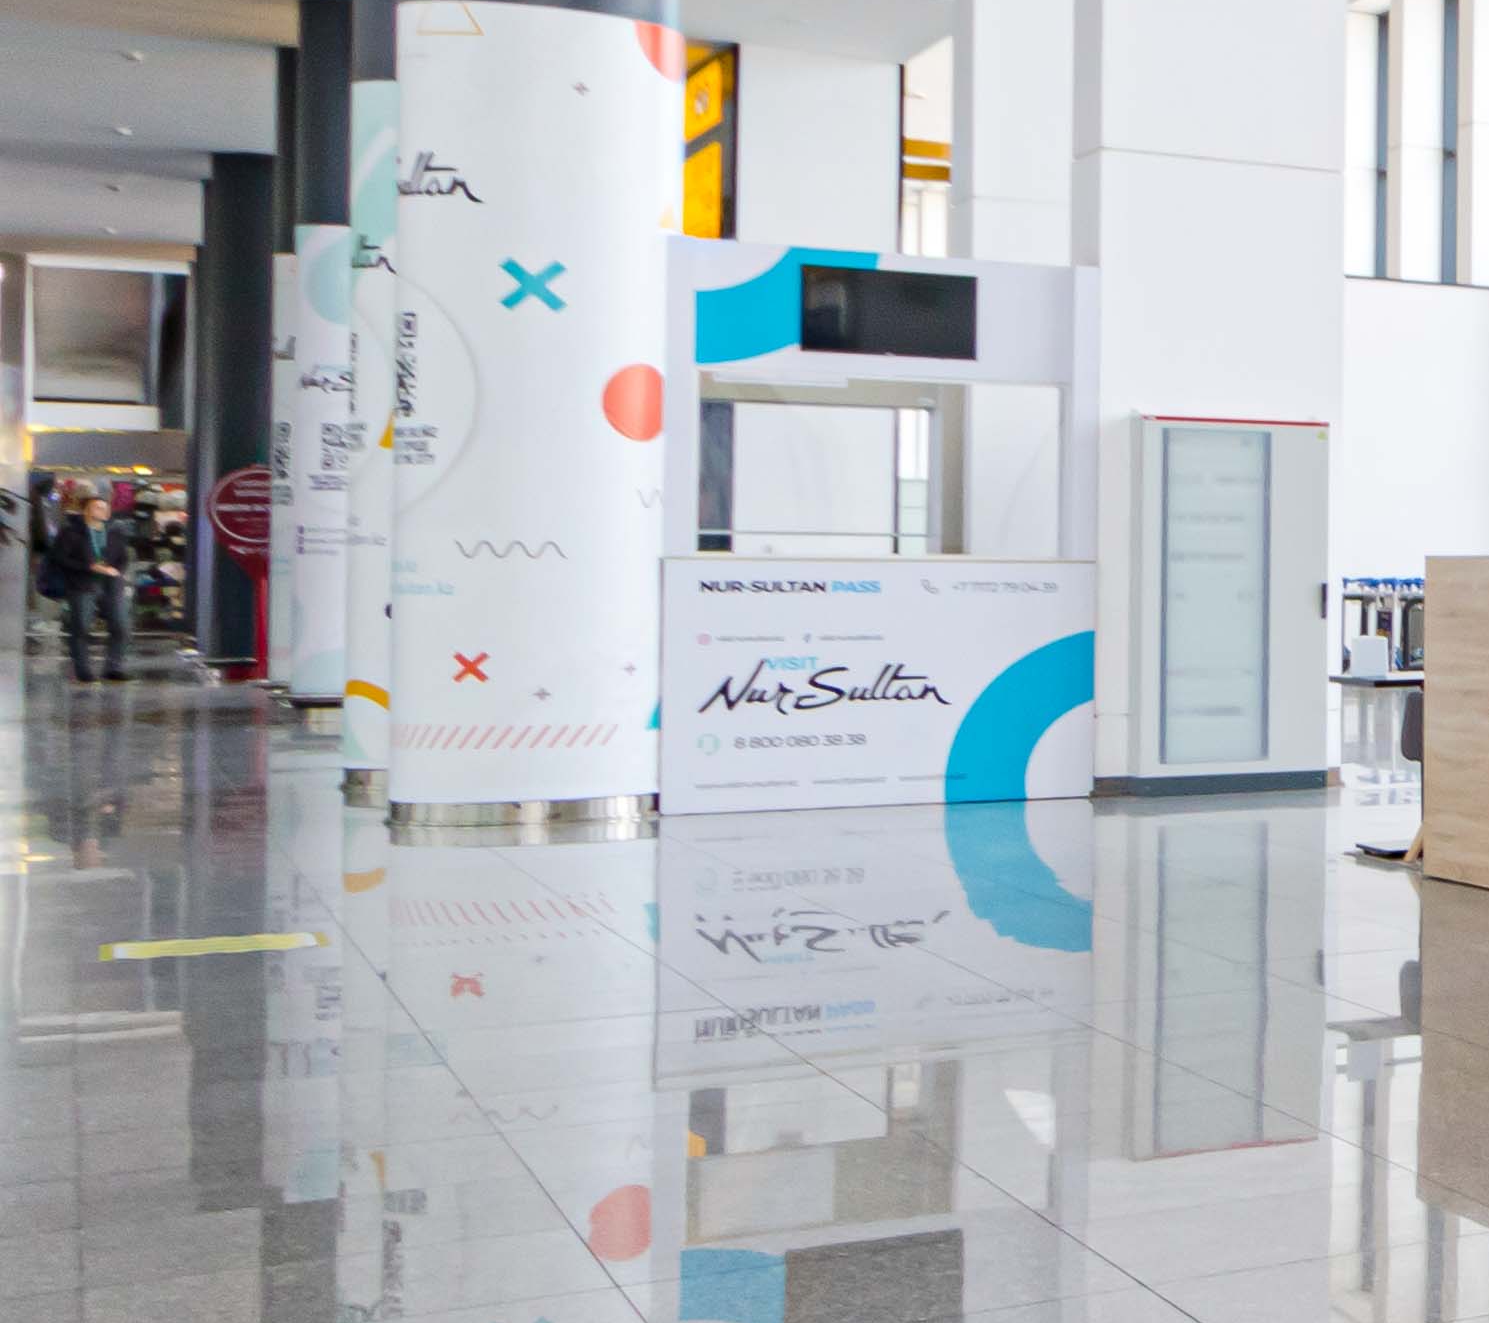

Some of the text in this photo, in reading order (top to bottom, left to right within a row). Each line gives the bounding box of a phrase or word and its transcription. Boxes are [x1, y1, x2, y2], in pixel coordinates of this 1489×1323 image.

[699, 579, 881, 593] NUR-SULTAN PASS
[765, 655, 819, 670] VISIT
